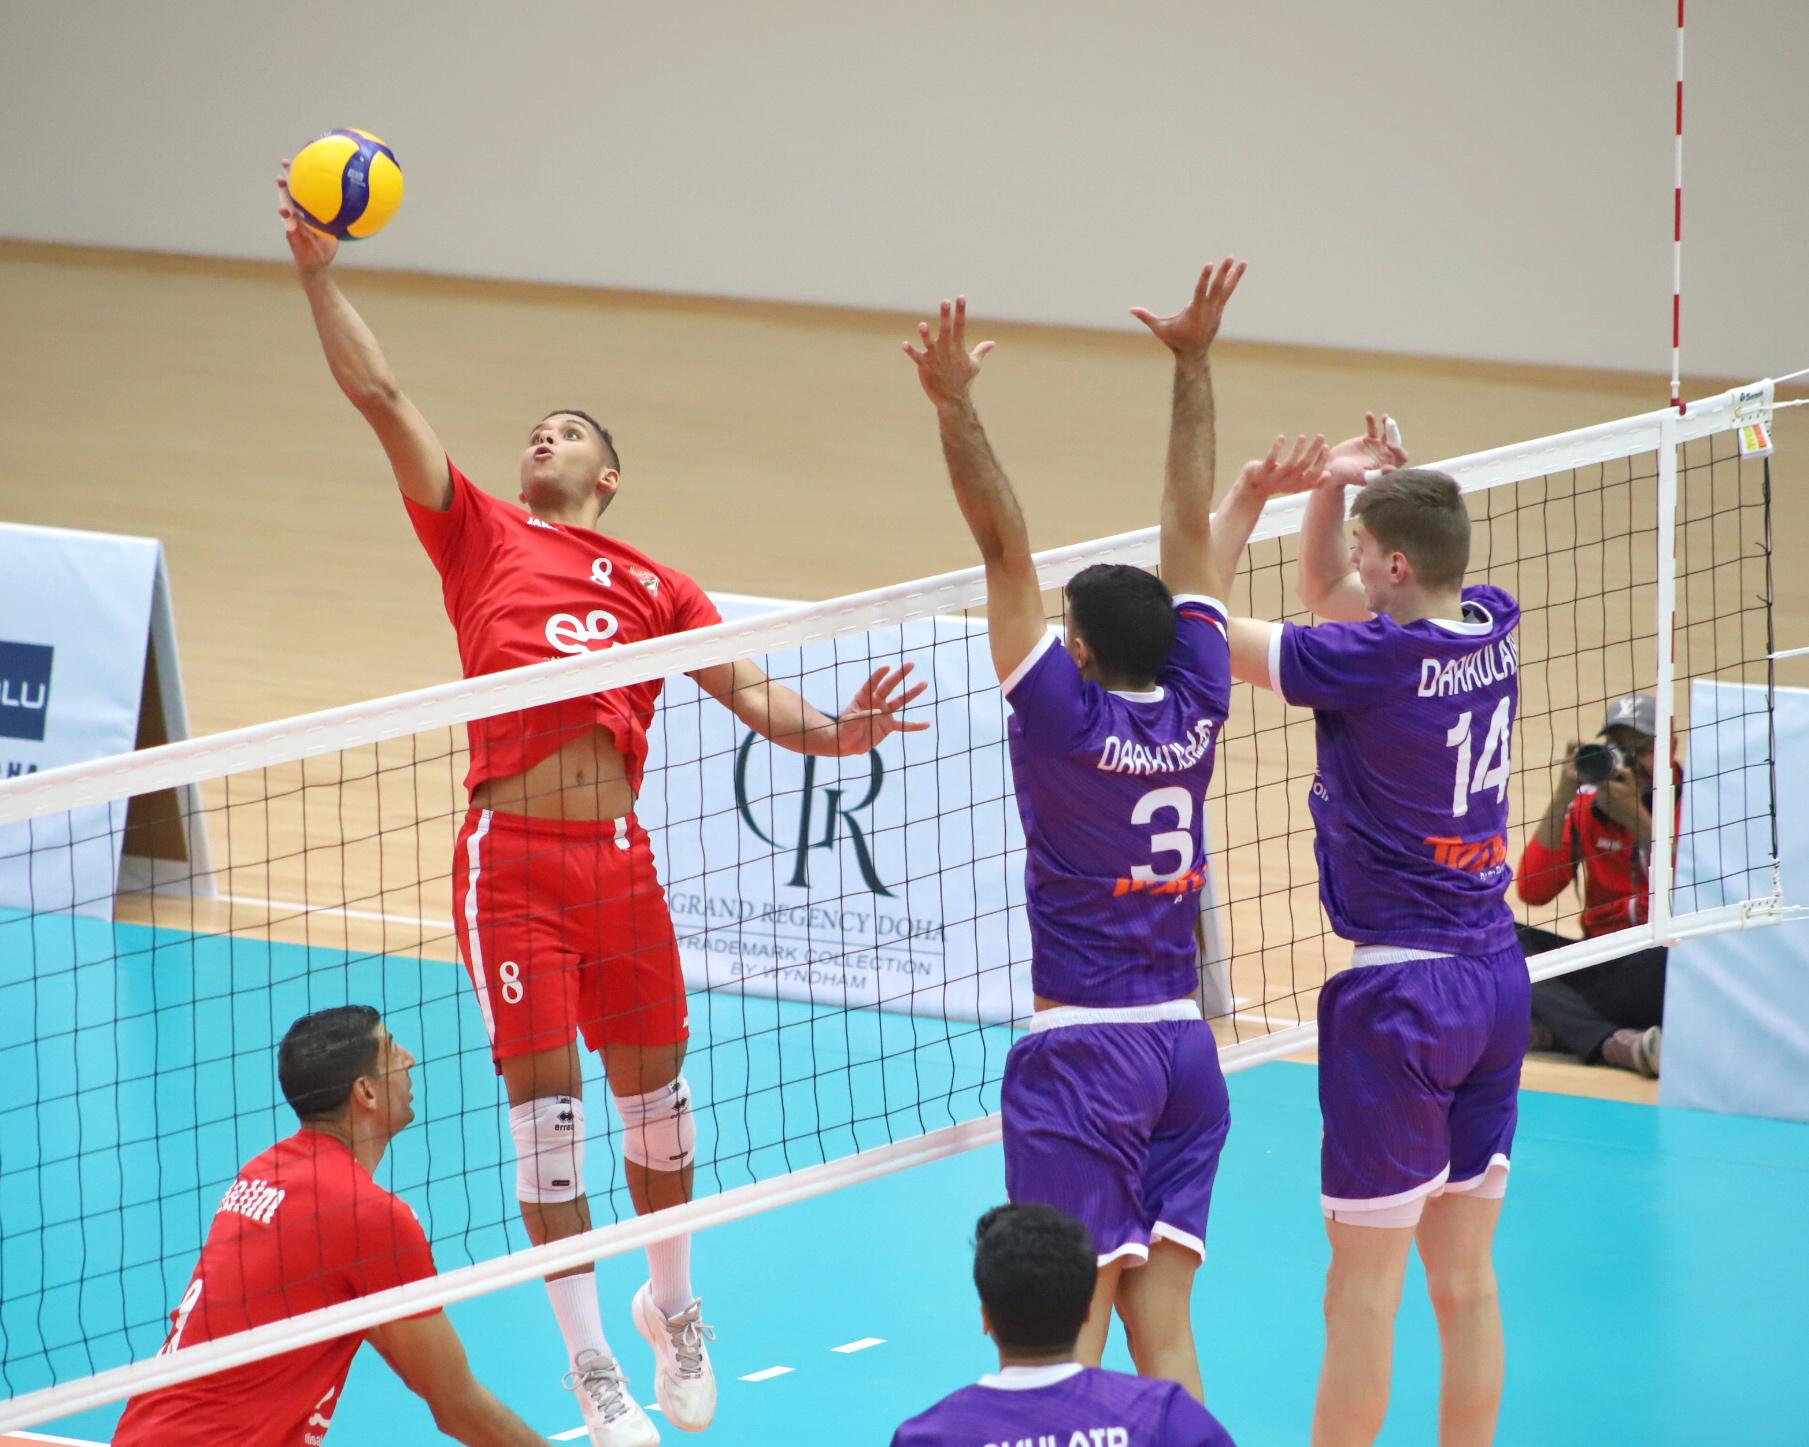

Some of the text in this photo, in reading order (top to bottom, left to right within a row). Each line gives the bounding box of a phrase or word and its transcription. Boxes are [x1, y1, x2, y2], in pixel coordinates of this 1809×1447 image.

[0, 679, 46, 709] LU
[1446, 696, 1510, 818] 14
[1130, 786, 1194, 882] 3
[670, 892, 947, 942] GRAND REGENCY DOHA
[676, 934, 932, 975] TRADEMARK COLLECTION
[730, 961, 867, 989] BY WYNDHAM
[499, 961, 524, 1004] 8
